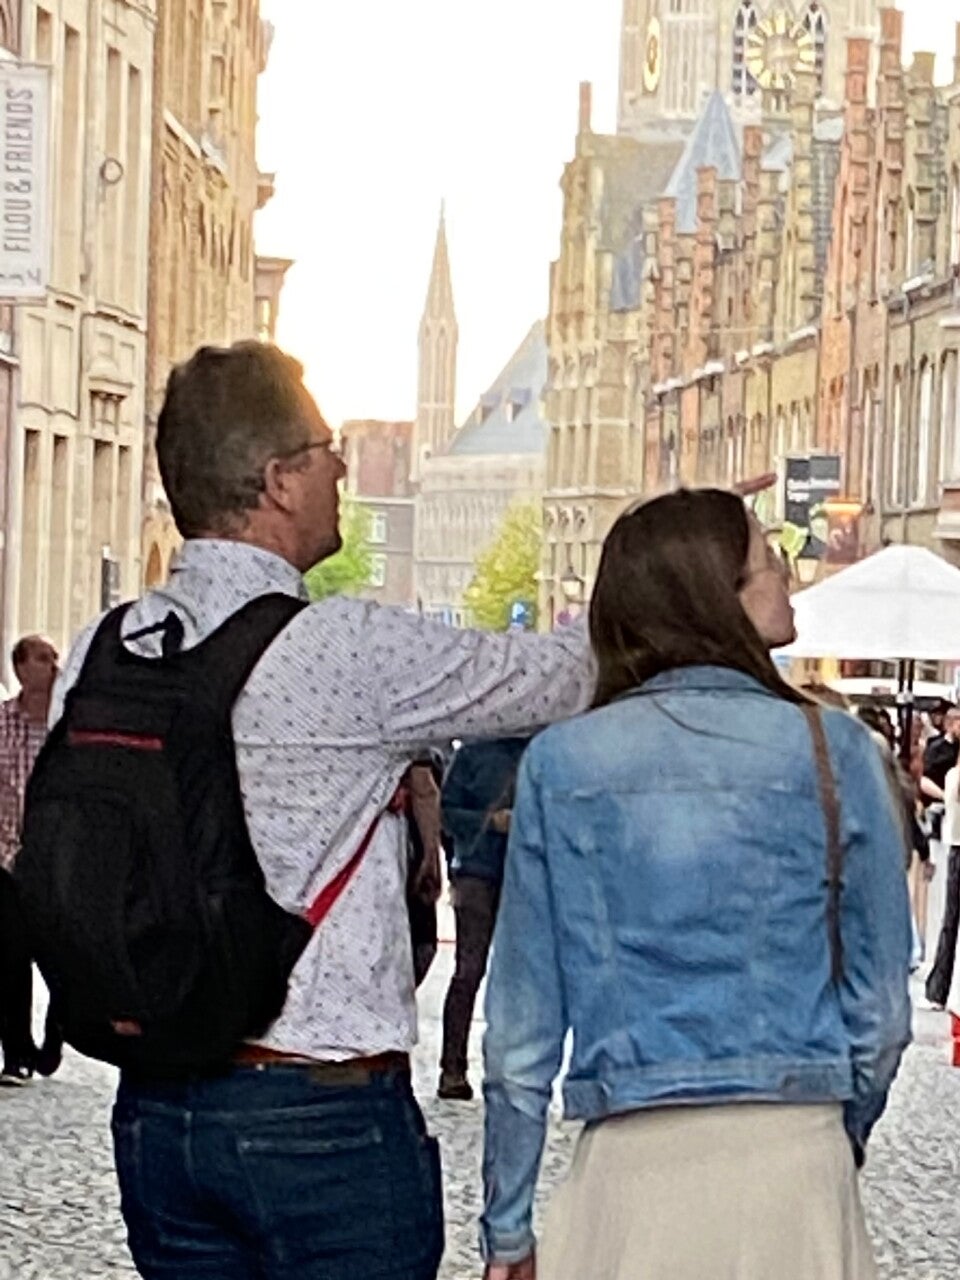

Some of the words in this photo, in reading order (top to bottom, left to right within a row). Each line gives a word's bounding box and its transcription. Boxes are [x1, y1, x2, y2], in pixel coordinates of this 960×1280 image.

[5, 88, 33, 172] FRIENDS
[4, 179, 32, 194] &
[3, 199, 31, 252] FILOU
